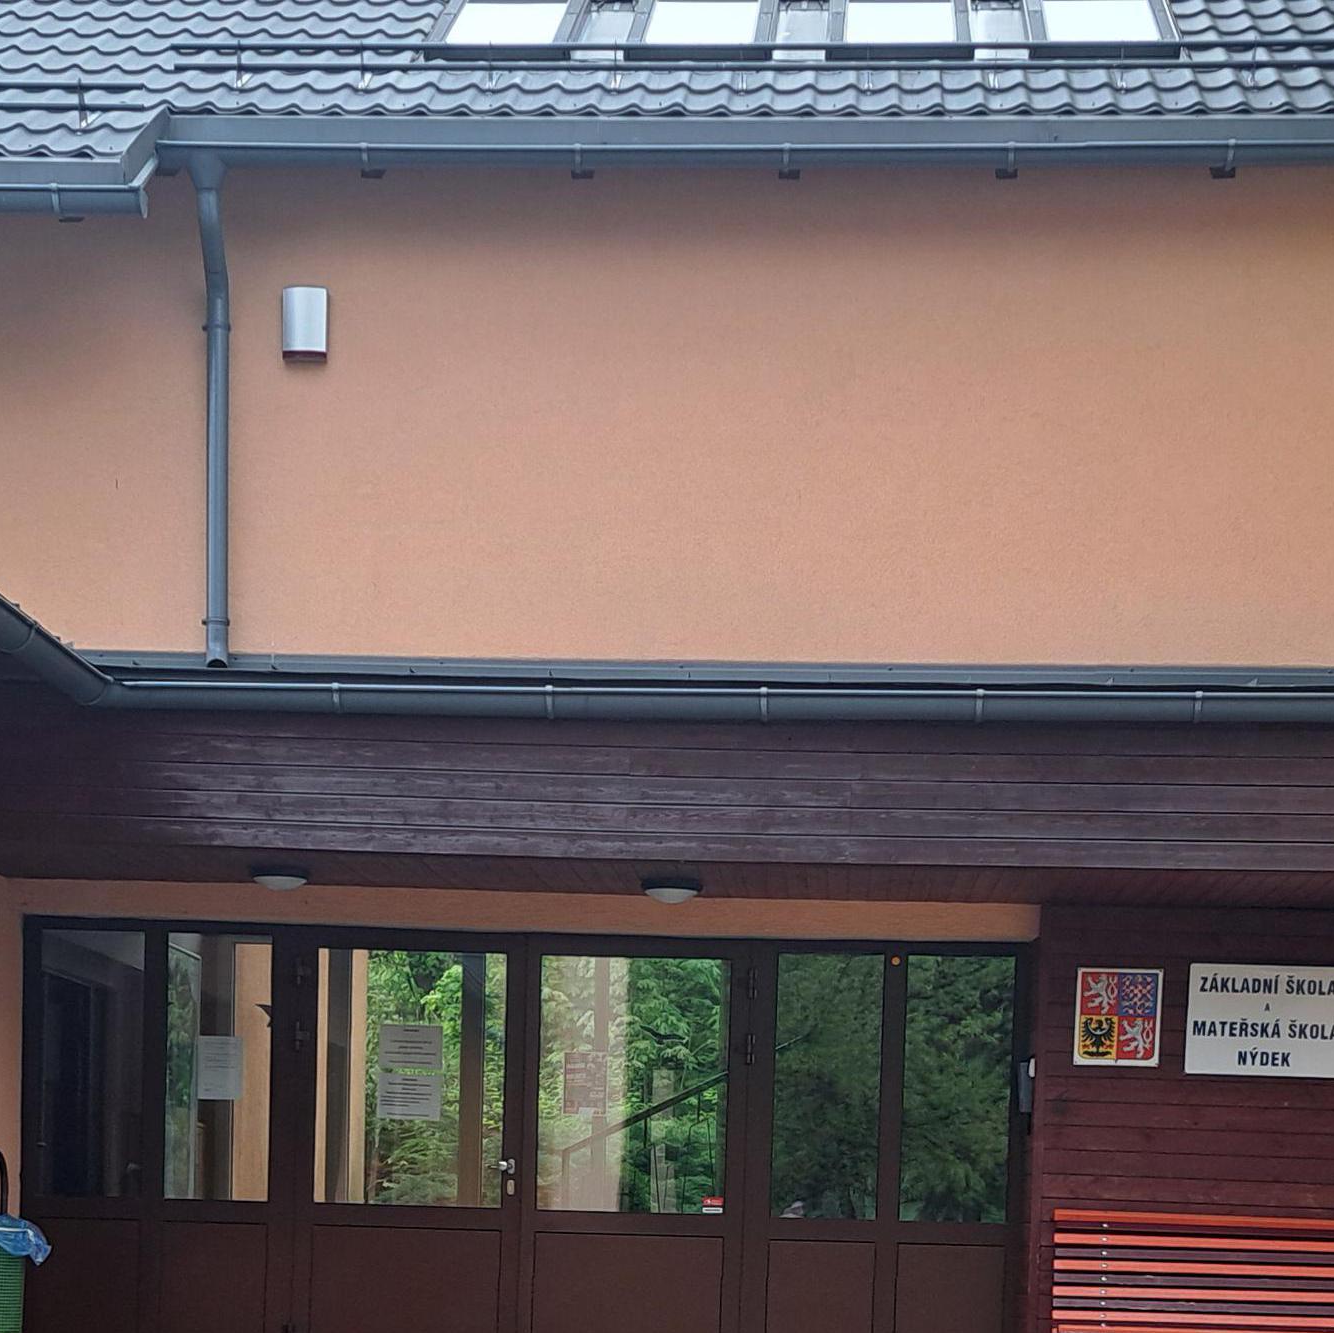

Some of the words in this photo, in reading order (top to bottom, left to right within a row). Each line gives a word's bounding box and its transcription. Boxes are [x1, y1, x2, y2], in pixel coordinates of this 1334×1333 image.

[1199, 973, 1280, 994] ZÁKLADNÍ
[1264, 1003, 1270, 1011] A
[1192, 1018, 1281, 1039] MATEŘSKÁ
[1237, 1047, 1291, 1067] NÝDEK
